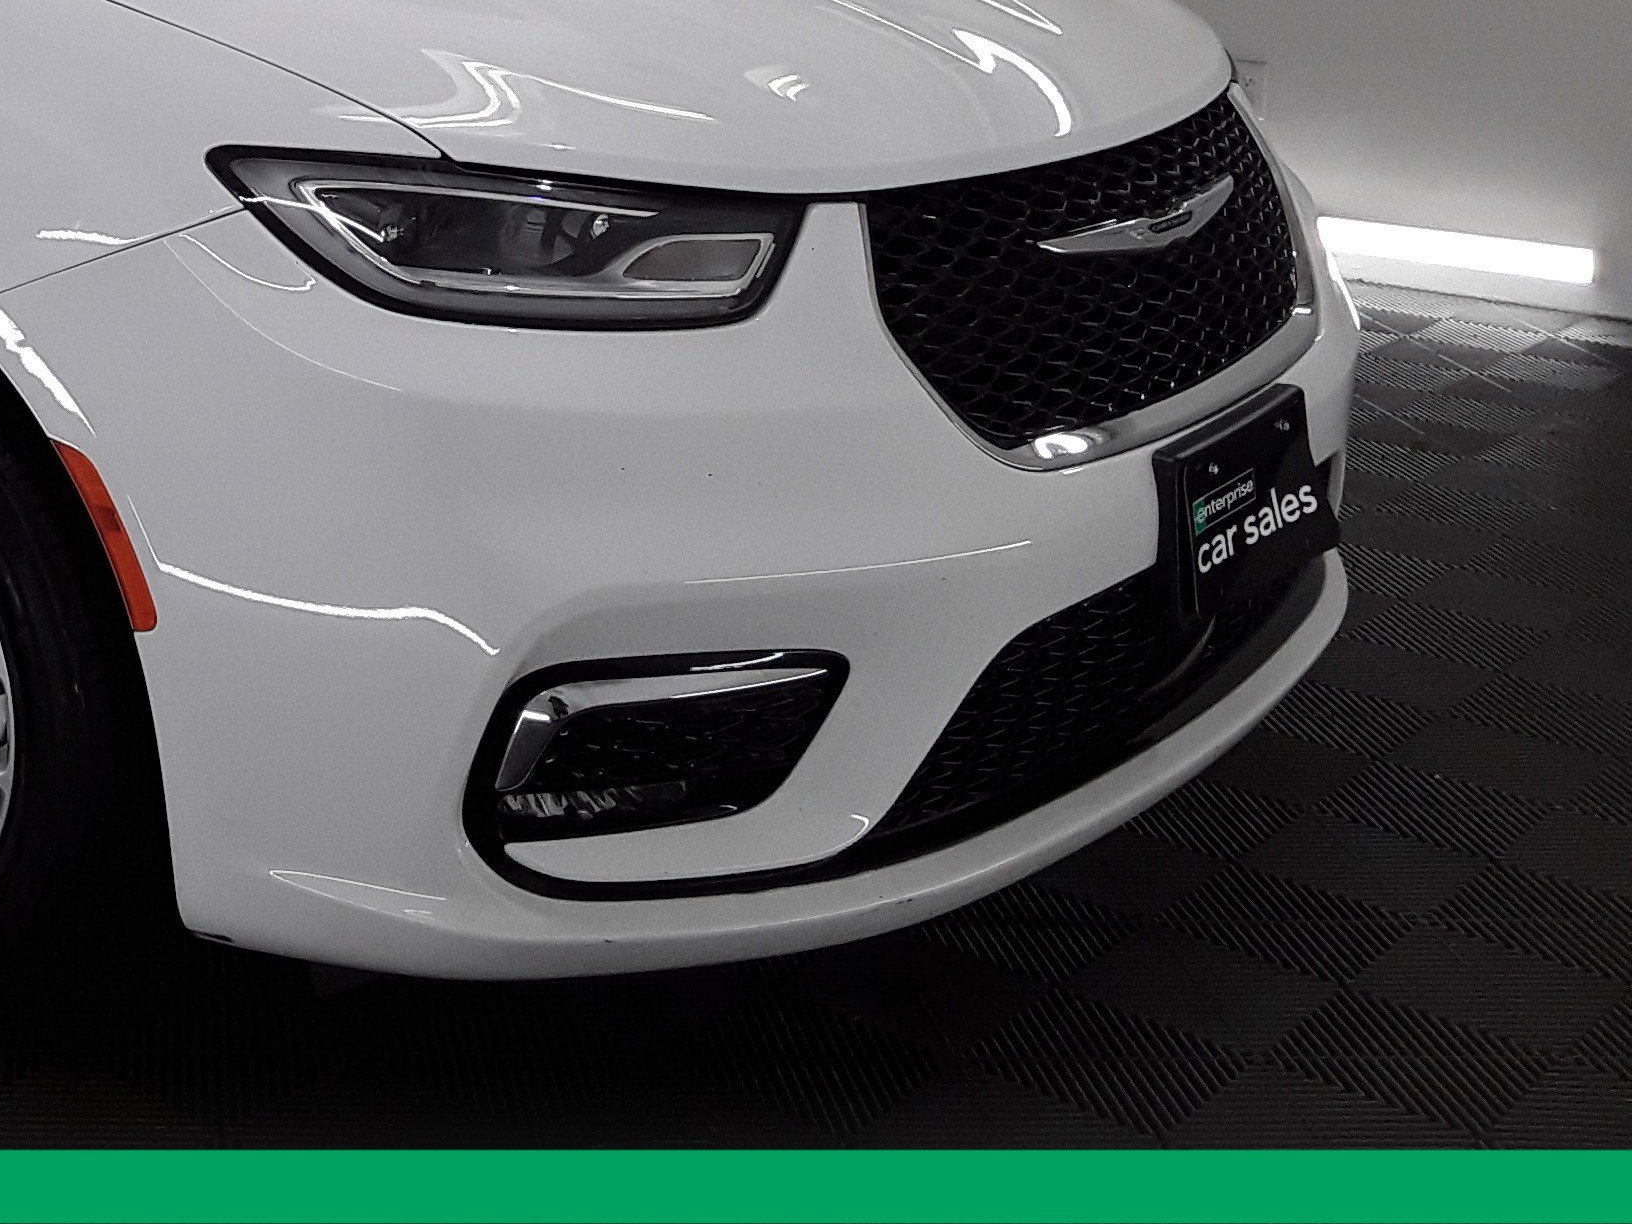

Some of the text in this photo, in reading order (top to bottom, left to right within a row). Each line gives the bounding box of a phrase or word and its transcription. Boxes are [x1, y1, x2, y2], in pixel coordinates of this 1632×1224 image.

[1195, 479, 1254, 523] enterprise
[1197, 485, 1318, 574] car sales
